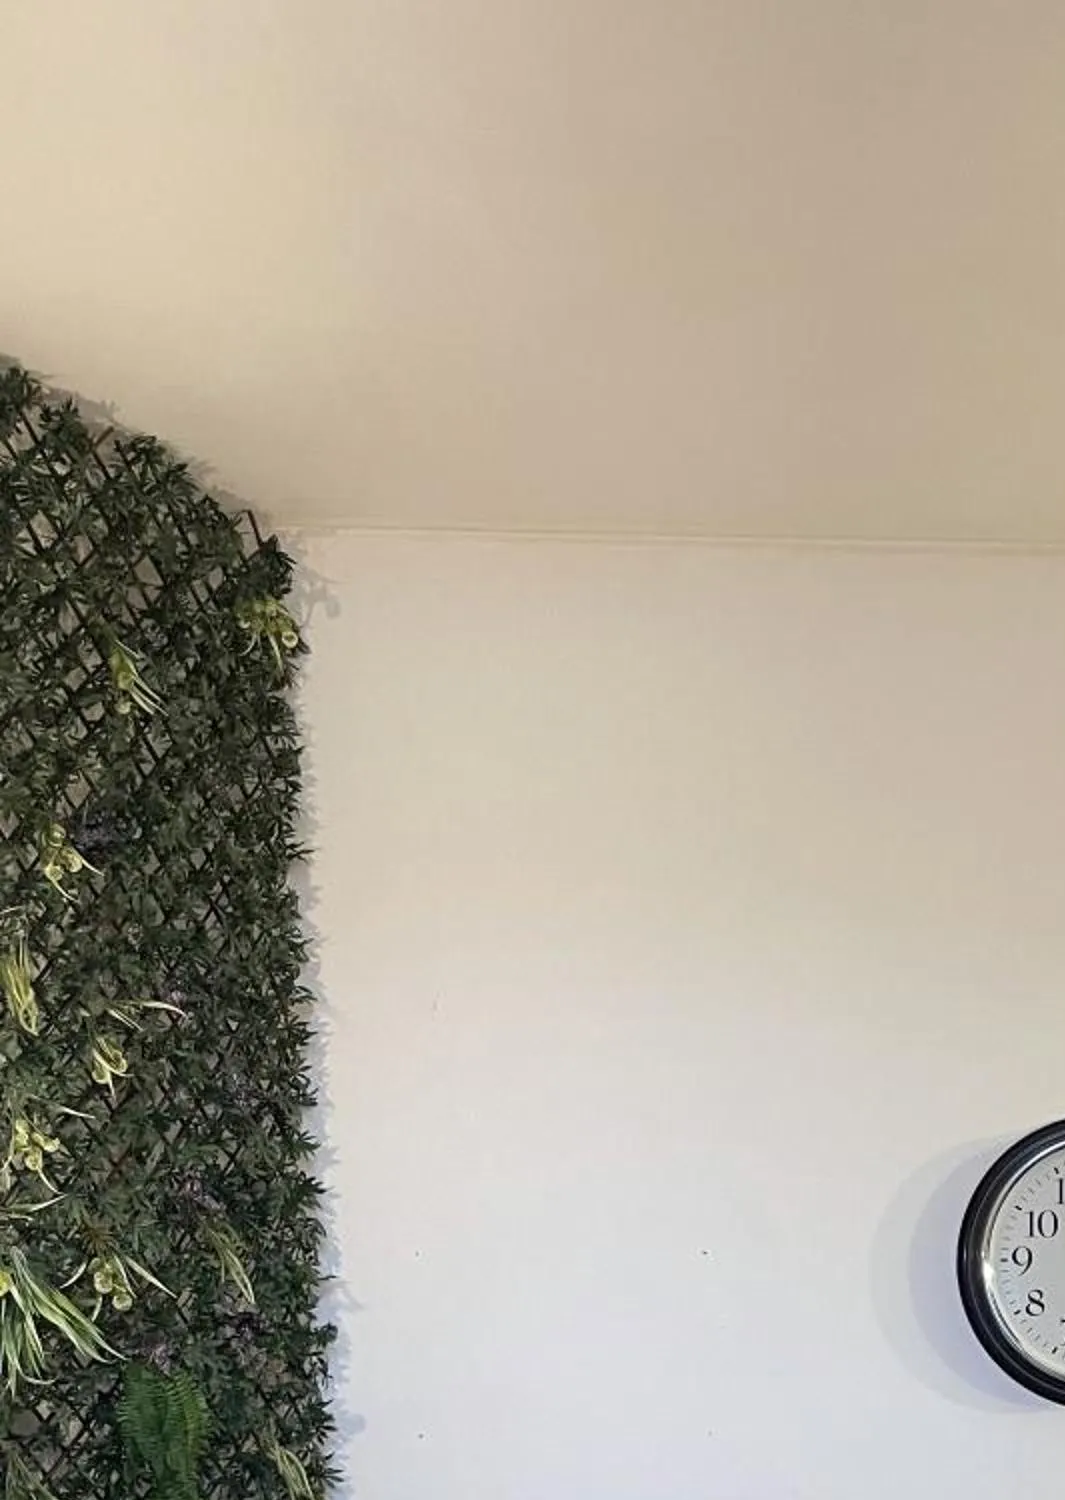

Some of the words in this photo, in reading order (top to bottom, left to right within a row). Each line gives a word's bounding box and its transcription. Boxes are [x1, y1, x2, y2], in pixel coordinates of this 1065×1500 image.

[1027, 1209, 1059, 1238] 10
[1011, 1246, 1033, 1275] 9
[1025, 1289, 1046, 1316] 8
